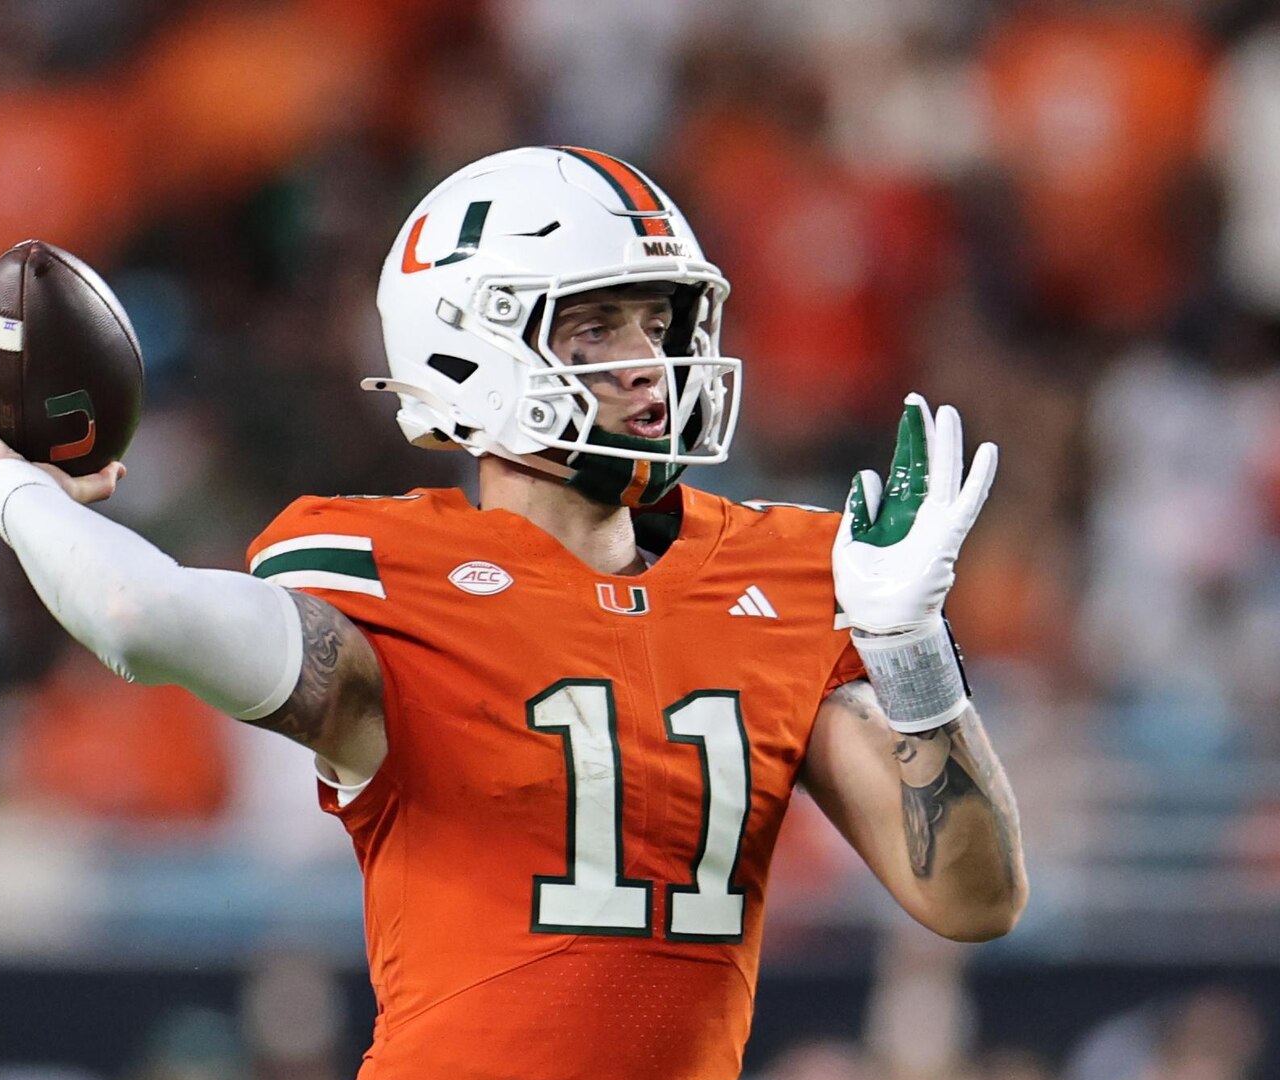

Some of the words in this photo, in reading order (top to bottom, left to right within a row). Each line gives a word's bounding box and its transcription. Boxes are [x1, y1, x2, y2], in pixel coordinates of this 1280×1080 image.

[460, 570, 502, 583] ACC
[595, 583, 651, 616] U
[524, 677, 752, 944] 11
